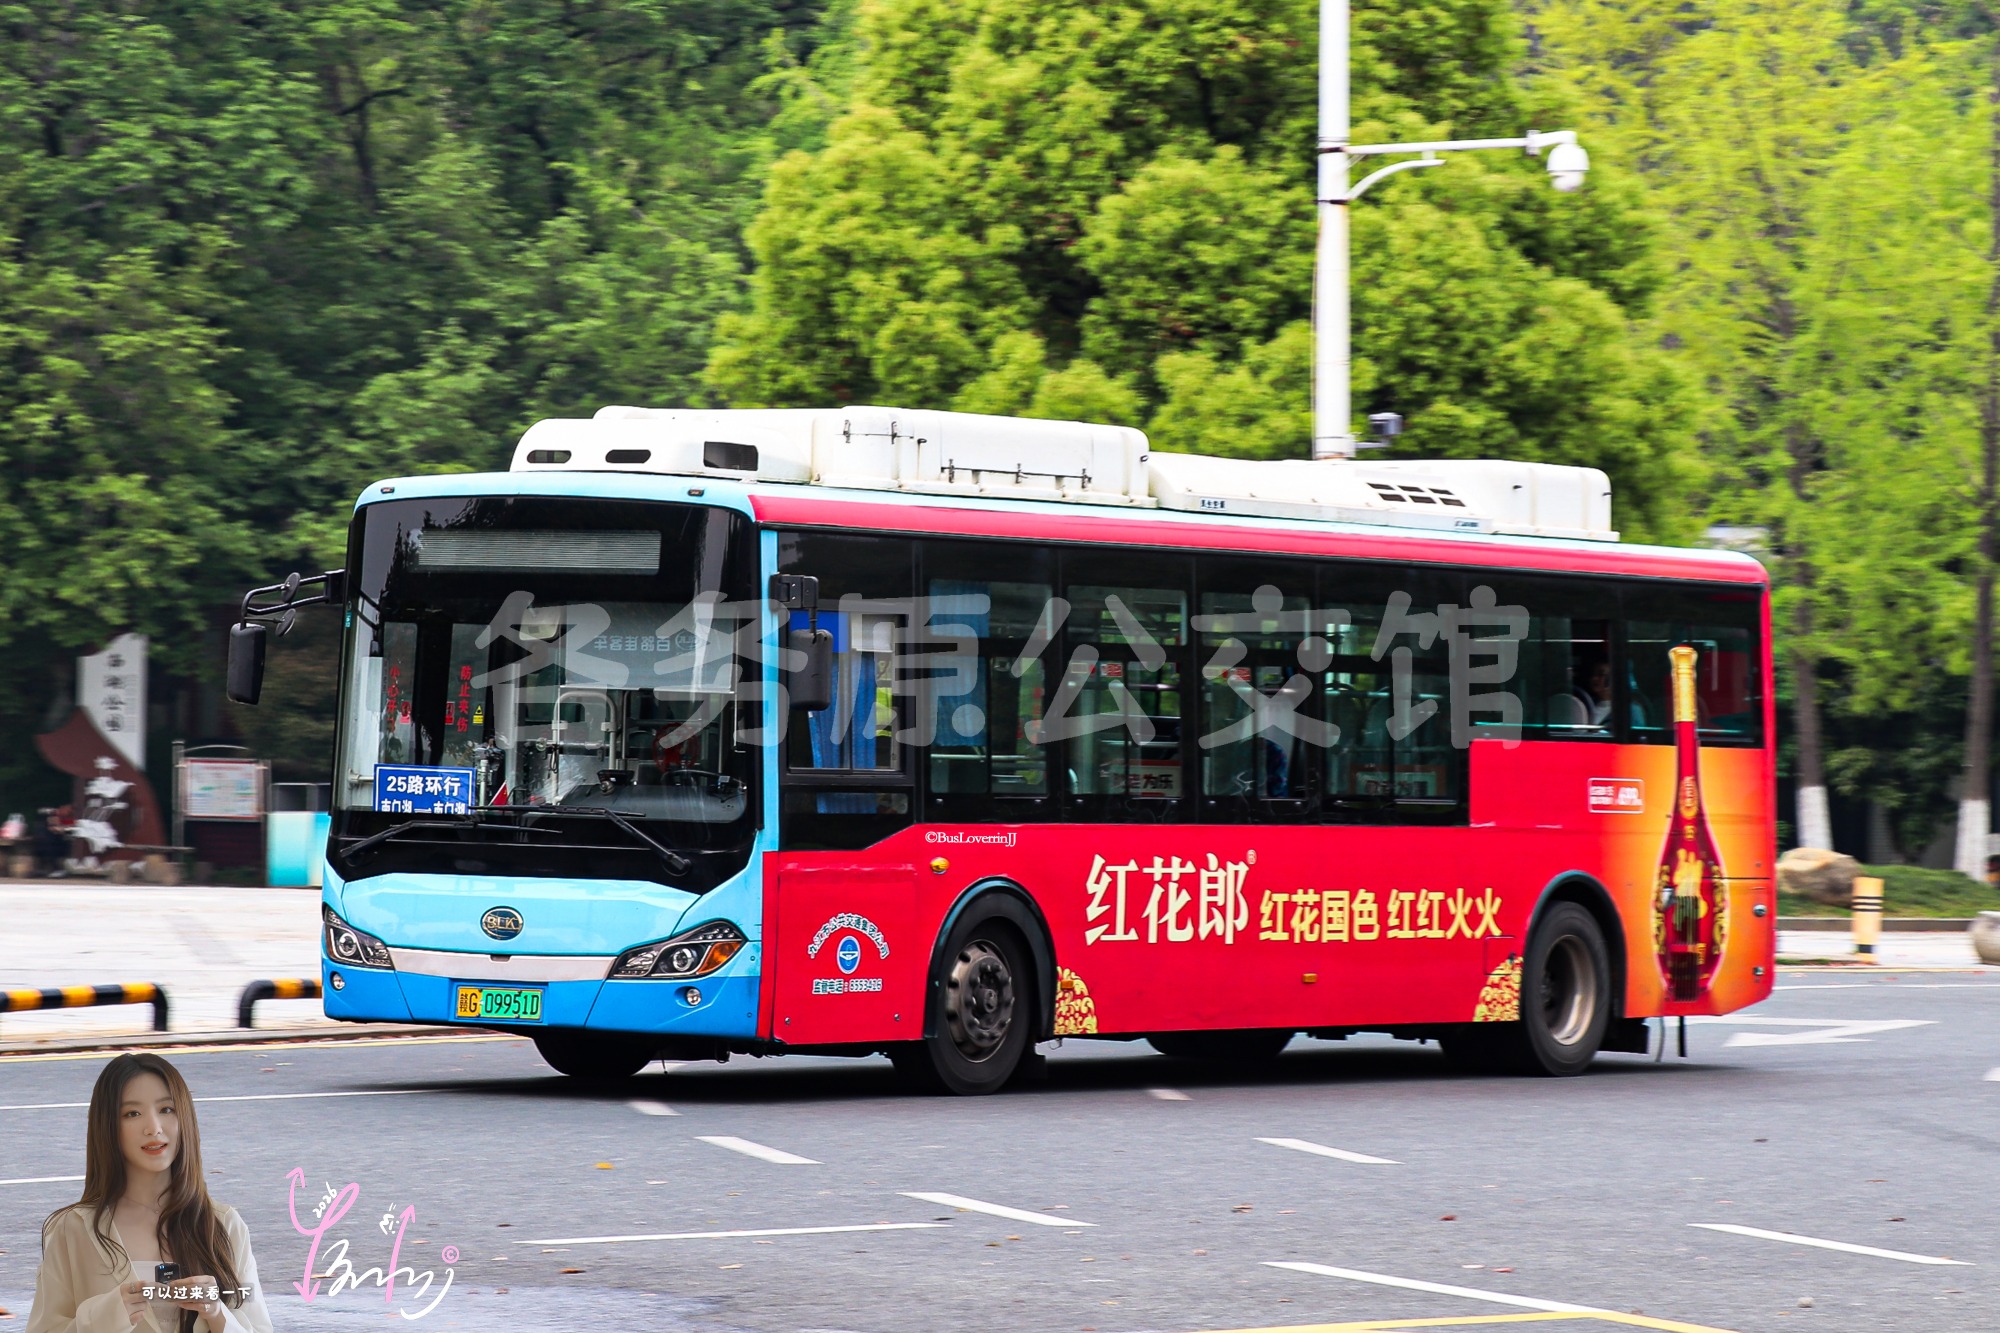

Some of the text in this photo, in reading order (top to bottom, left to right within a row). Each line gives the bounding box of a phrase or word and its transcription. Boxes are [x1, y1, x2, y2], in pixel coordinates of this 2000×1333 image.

[457, 665, 472, 733] 防止夹伤
[387, 775, 461, 797] 25路环行
[1084, 853, 1249, 946] 红花郎
[1259, 887, 1502, 943] 红花国色 红红火火
